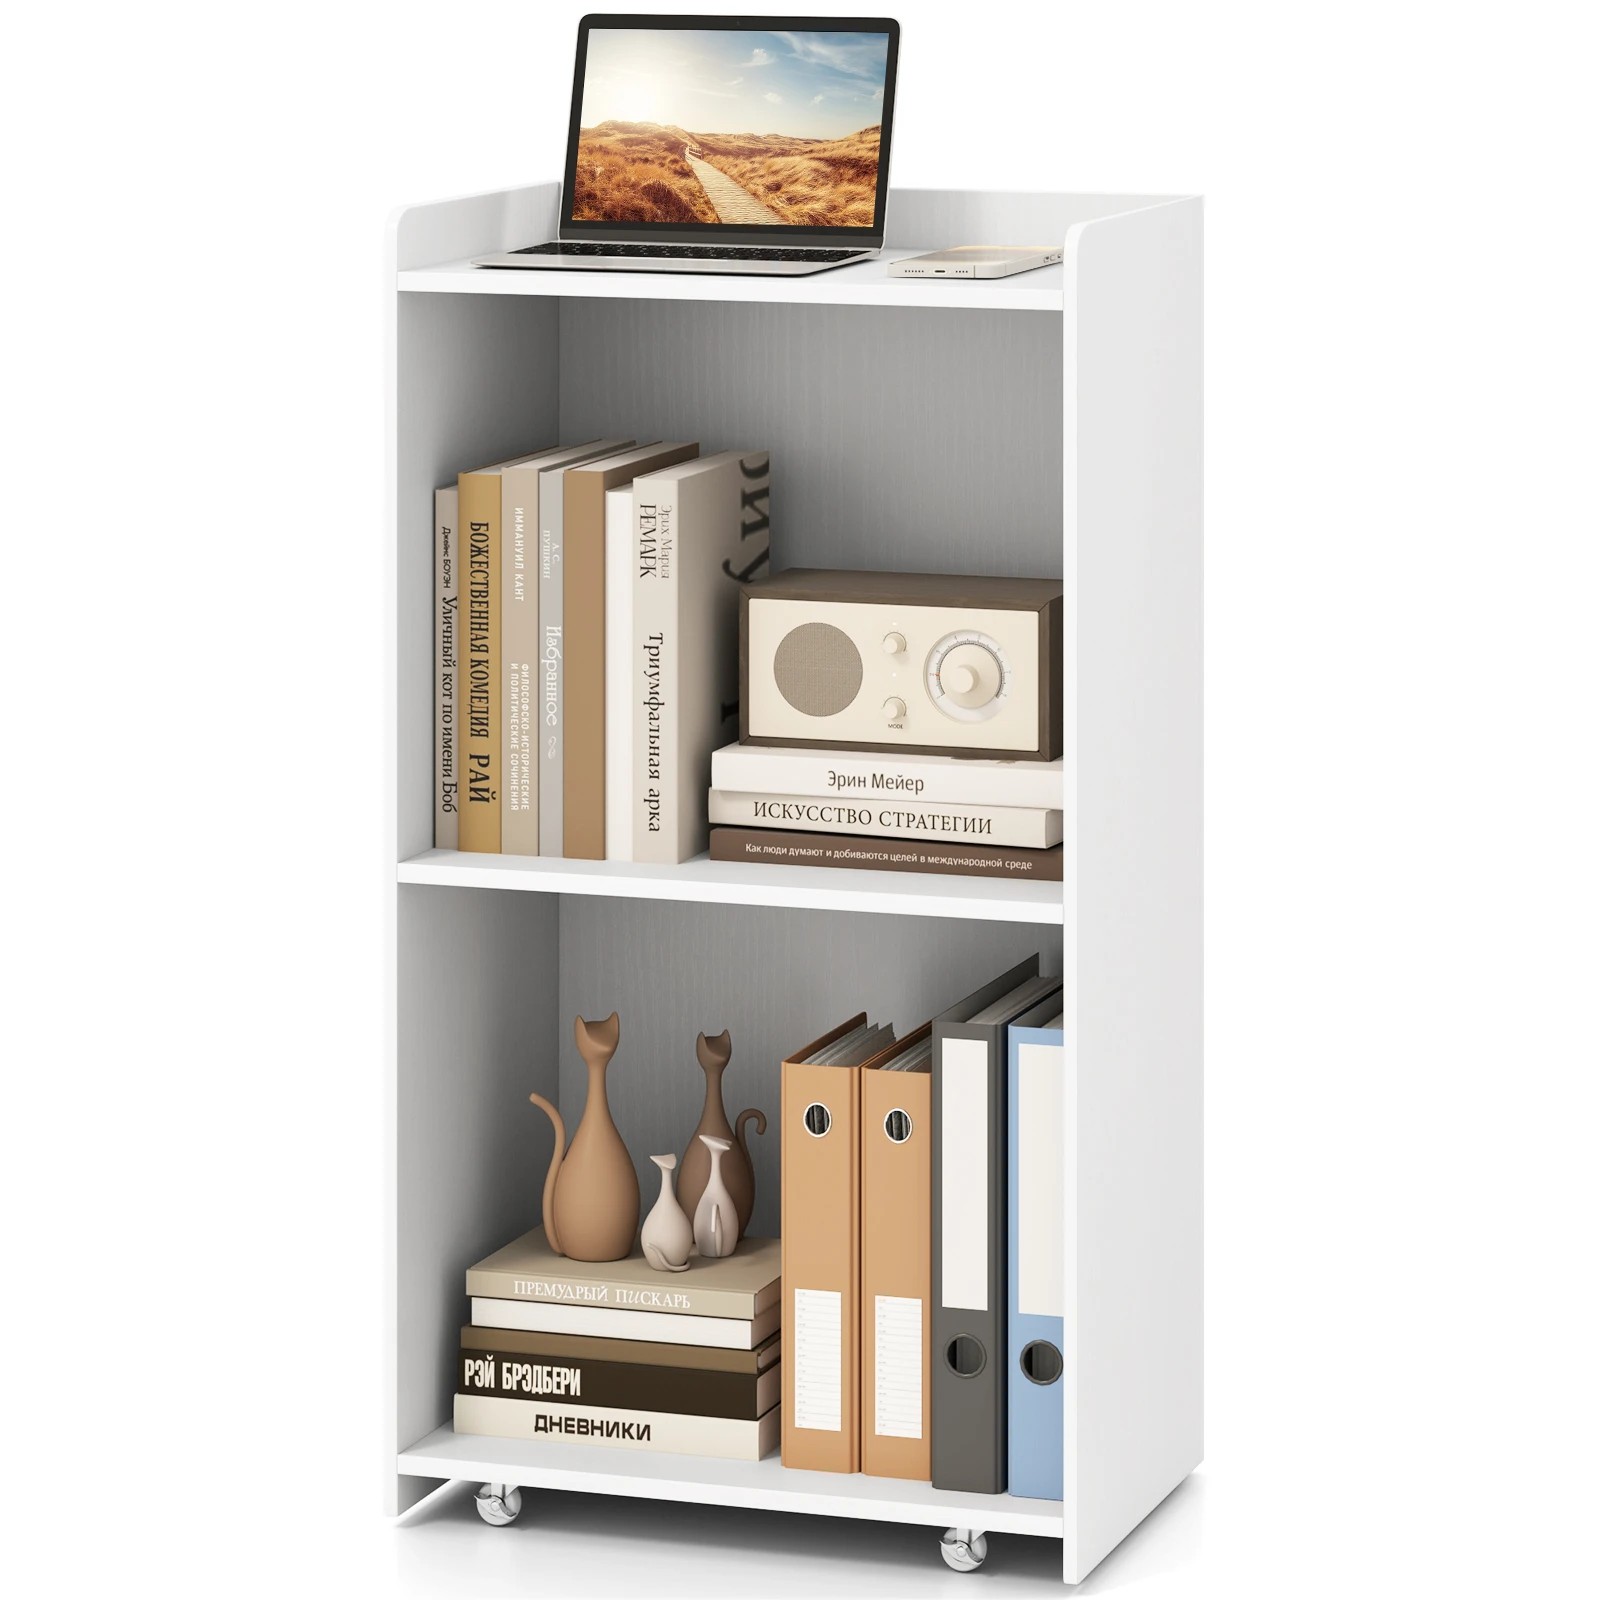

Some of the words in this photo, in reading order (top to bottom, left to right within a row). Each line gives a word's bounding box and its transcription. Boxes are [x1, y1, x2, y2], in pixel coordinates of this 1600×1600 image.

[515, 508, 524, 569] ИММАНУИЛ
[639, 504, 656, 578] РЕМАРК
[661, 505, 672, 535] Эрих
[660, 539, 672, 579] Мария
[470, 522, 489, 653] БОЖЕСТВЕННАЯ
[515, 574, 524, 601] КАНТ
[441, 597, 457, 668] Уличный
[442, 673, 453, 699] кот
[542, 625, 562, 726] Избранное
[442, 704, 453, 723] по
[466, 658, 489, 738] КОМЕДИЯ
[510, 674, 519, 749] ПОЛИТИЧЕСКИЕ
[644, 633, 664, 780] Триумфальная
[442, 727, 453, 778] имени
[521, 664, 529, 810] ФИЛОСОФСКО-ИСТОРИЧЕСКИЕ
[442, 781, 457, 812] Боб
[469, 754, 495, 803] РАЙ
[510, 754, 519, 810] СОЧИНЕНИЯ
[828, 771, 866, 791] Эрин
[872, 773, 924, 795] Мейер
[645, 788, 661, 832] арка
[753, 802, 872, 826] ИСКУССТВО
[879, 810, 992, 835] СТРАТЕГИИ
[745, 844, 761, 853] Как
[763, 846, 788, 855] люди
[789, 846, 823, 857] думают
[833, 849, 888, 860] добиваются
[890, 852, 917, 862] целей
[928, 856, 1002, 868] международной
[1005, 860, 1032, 870] среде
[514, 1280, 608, 1302] ПРЕМУДРЫЙ
[464, 1355, 495, 1388] РЭЙ
[502, 1362, 581, 1397] БРЭДБЕРИ
[534, 1414, 651, 1441] ДНЕВНИКИ
